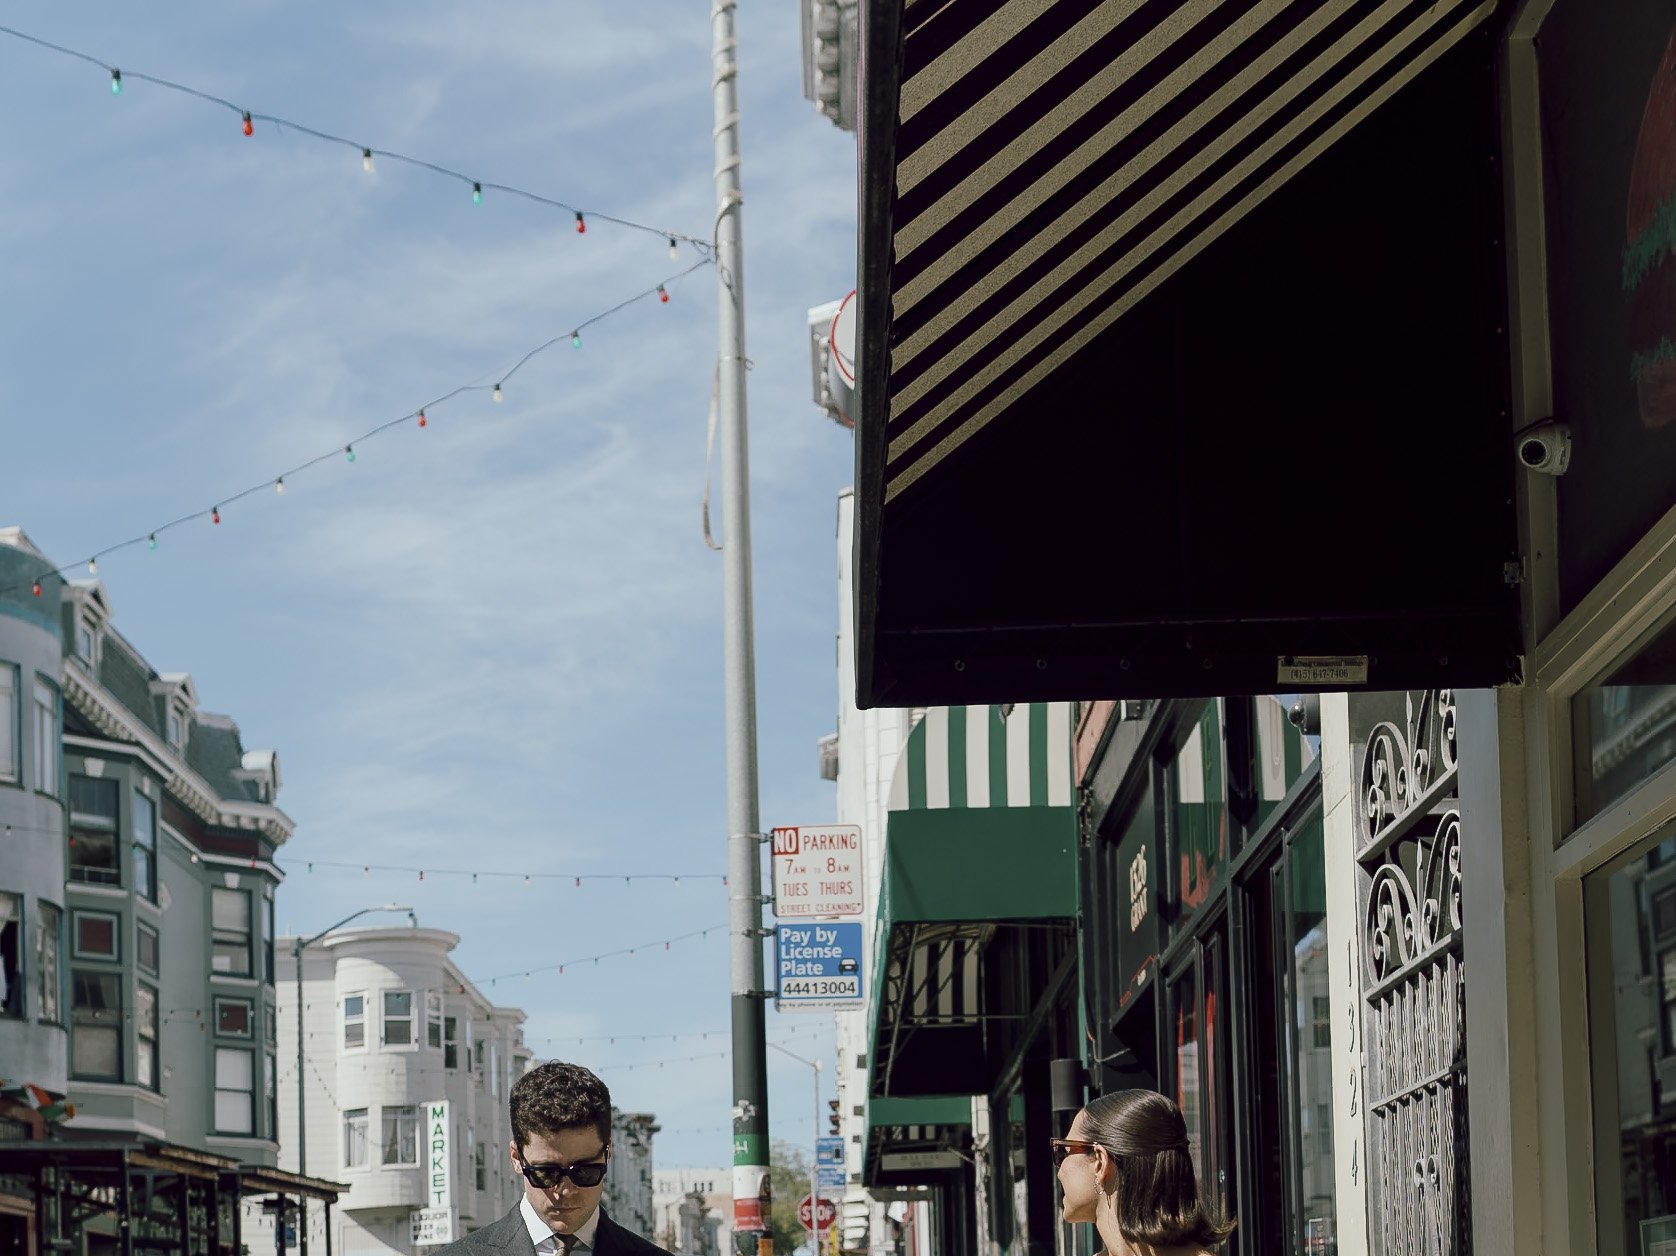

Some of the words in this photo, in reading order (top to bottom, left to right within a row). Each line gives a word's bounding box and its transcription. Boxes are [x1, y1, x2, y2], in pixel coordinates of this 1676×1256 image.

[773, 829, 798, 853] NO
[803, 834, 858, 850] PARKING
[783, 883, 808, 897] TUES
[819, 881, 853, 896] THURS
[780, 904, 811, 914] STREET
[815, 902, 858, 912] CLEANING
[780, 928, 812, 946] Pay
[816, 927, 837, 945] by
[781, 944, 843, 959] License
[781, 961, 824, 976] Plate
[783, 981, 856, 995] 44413004
[1347, 937, 1358, 1187] 1324
[432, 1105, 446, 1205] MARKET
[801, 1205, 834, 1221] SOP
